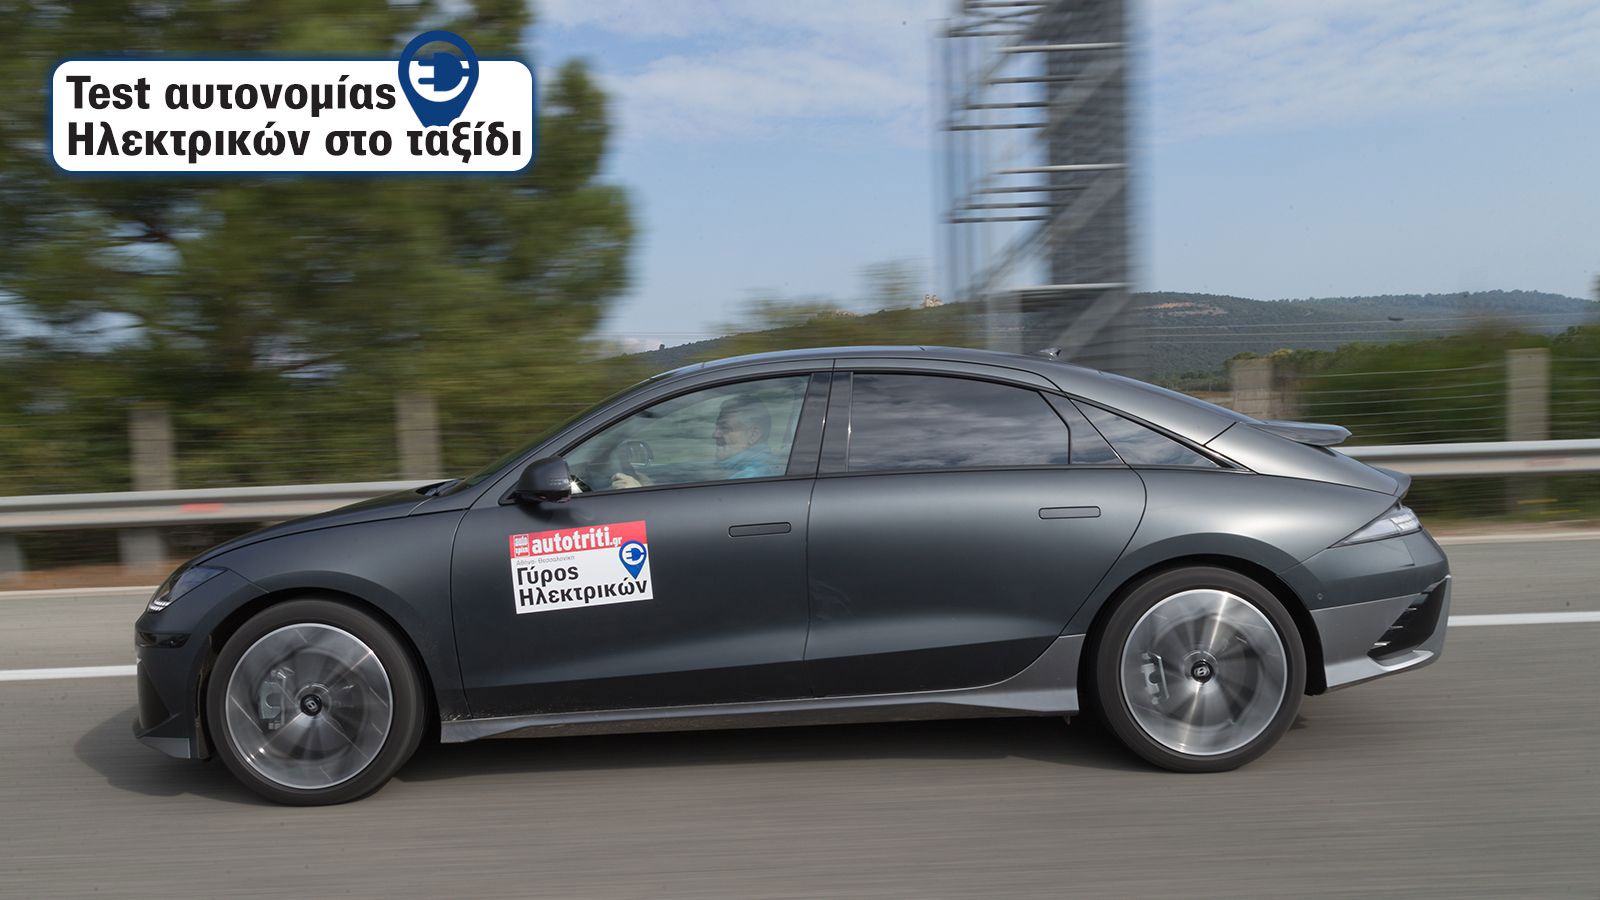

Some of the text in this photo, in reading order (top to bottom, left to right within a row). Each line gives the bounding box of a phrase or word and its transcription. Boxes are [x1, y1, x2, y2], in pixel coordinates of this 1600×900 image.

[531, 526, 623, 554] autotriti.gr
[517, 565, 579, 587] Γύρος
[519, 577, 647, 607] Ηλεκτρικών
